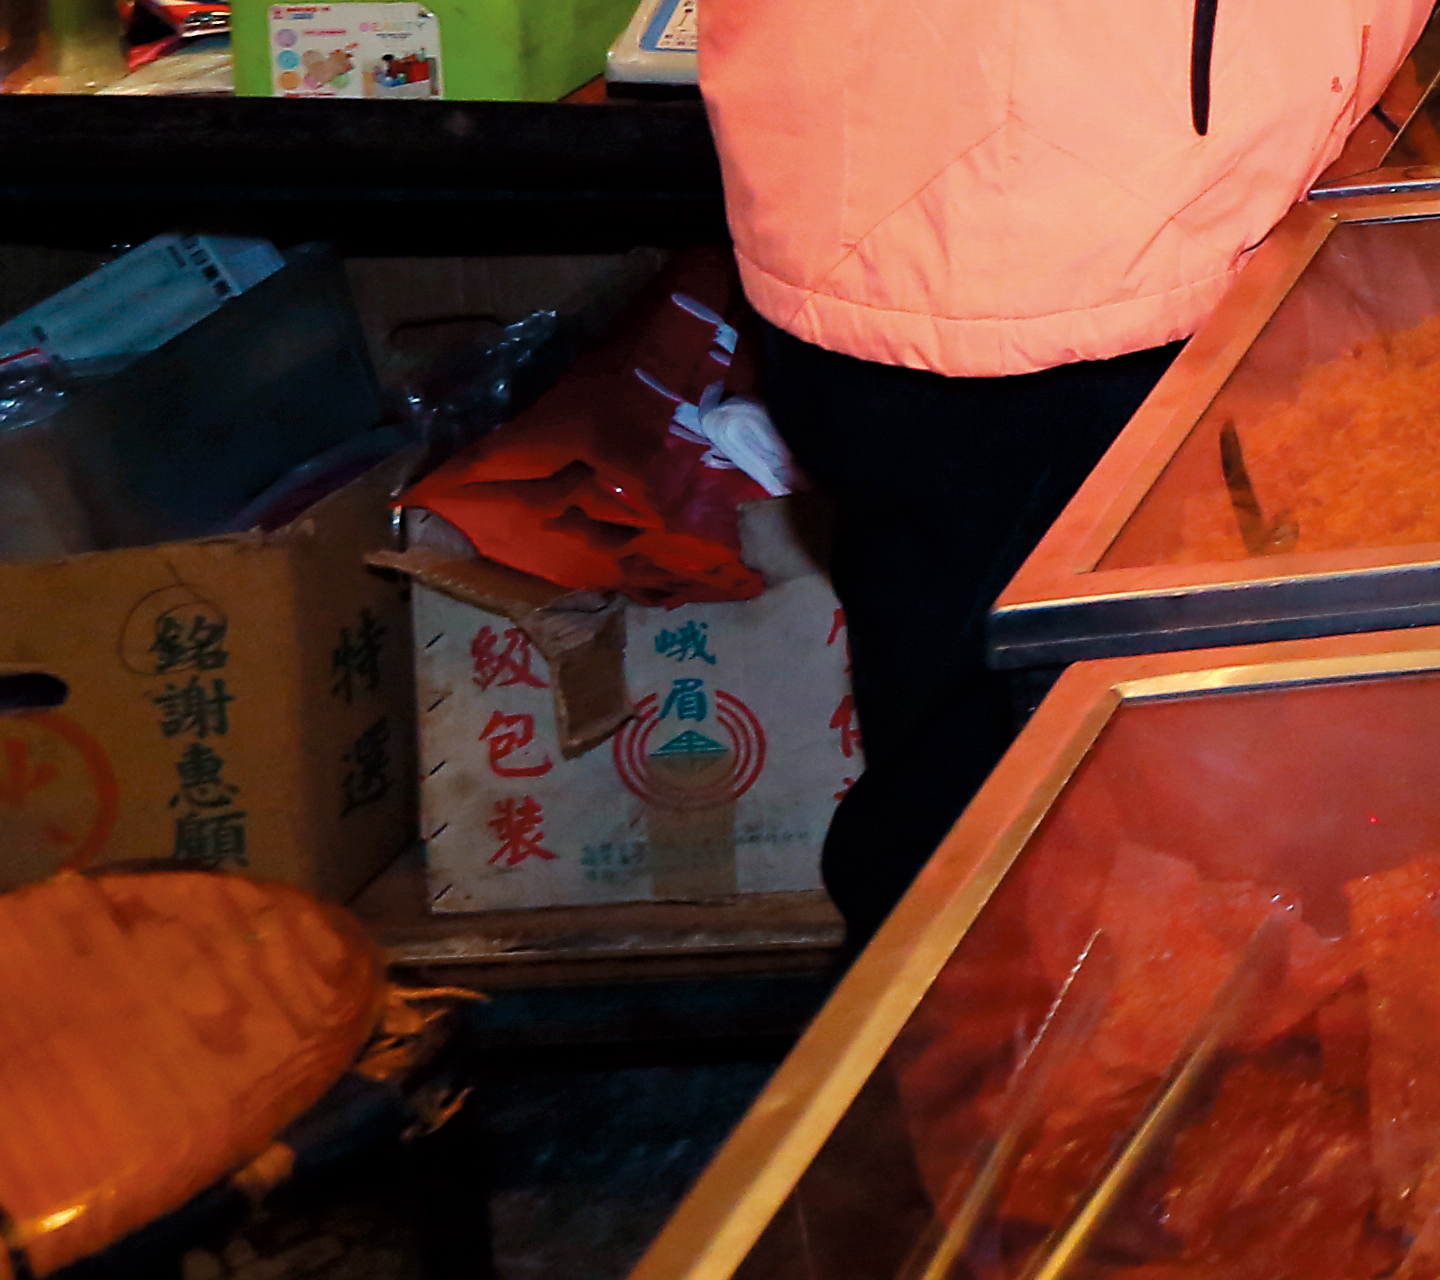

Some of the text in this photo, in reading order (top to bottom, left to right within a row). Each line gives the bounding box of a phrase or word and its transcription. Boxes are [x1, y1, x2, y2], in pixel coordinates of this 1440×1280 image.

[148, 614, 252, 868] 銘謝惠顧
[654, 619, 718, 723] 峨眉
